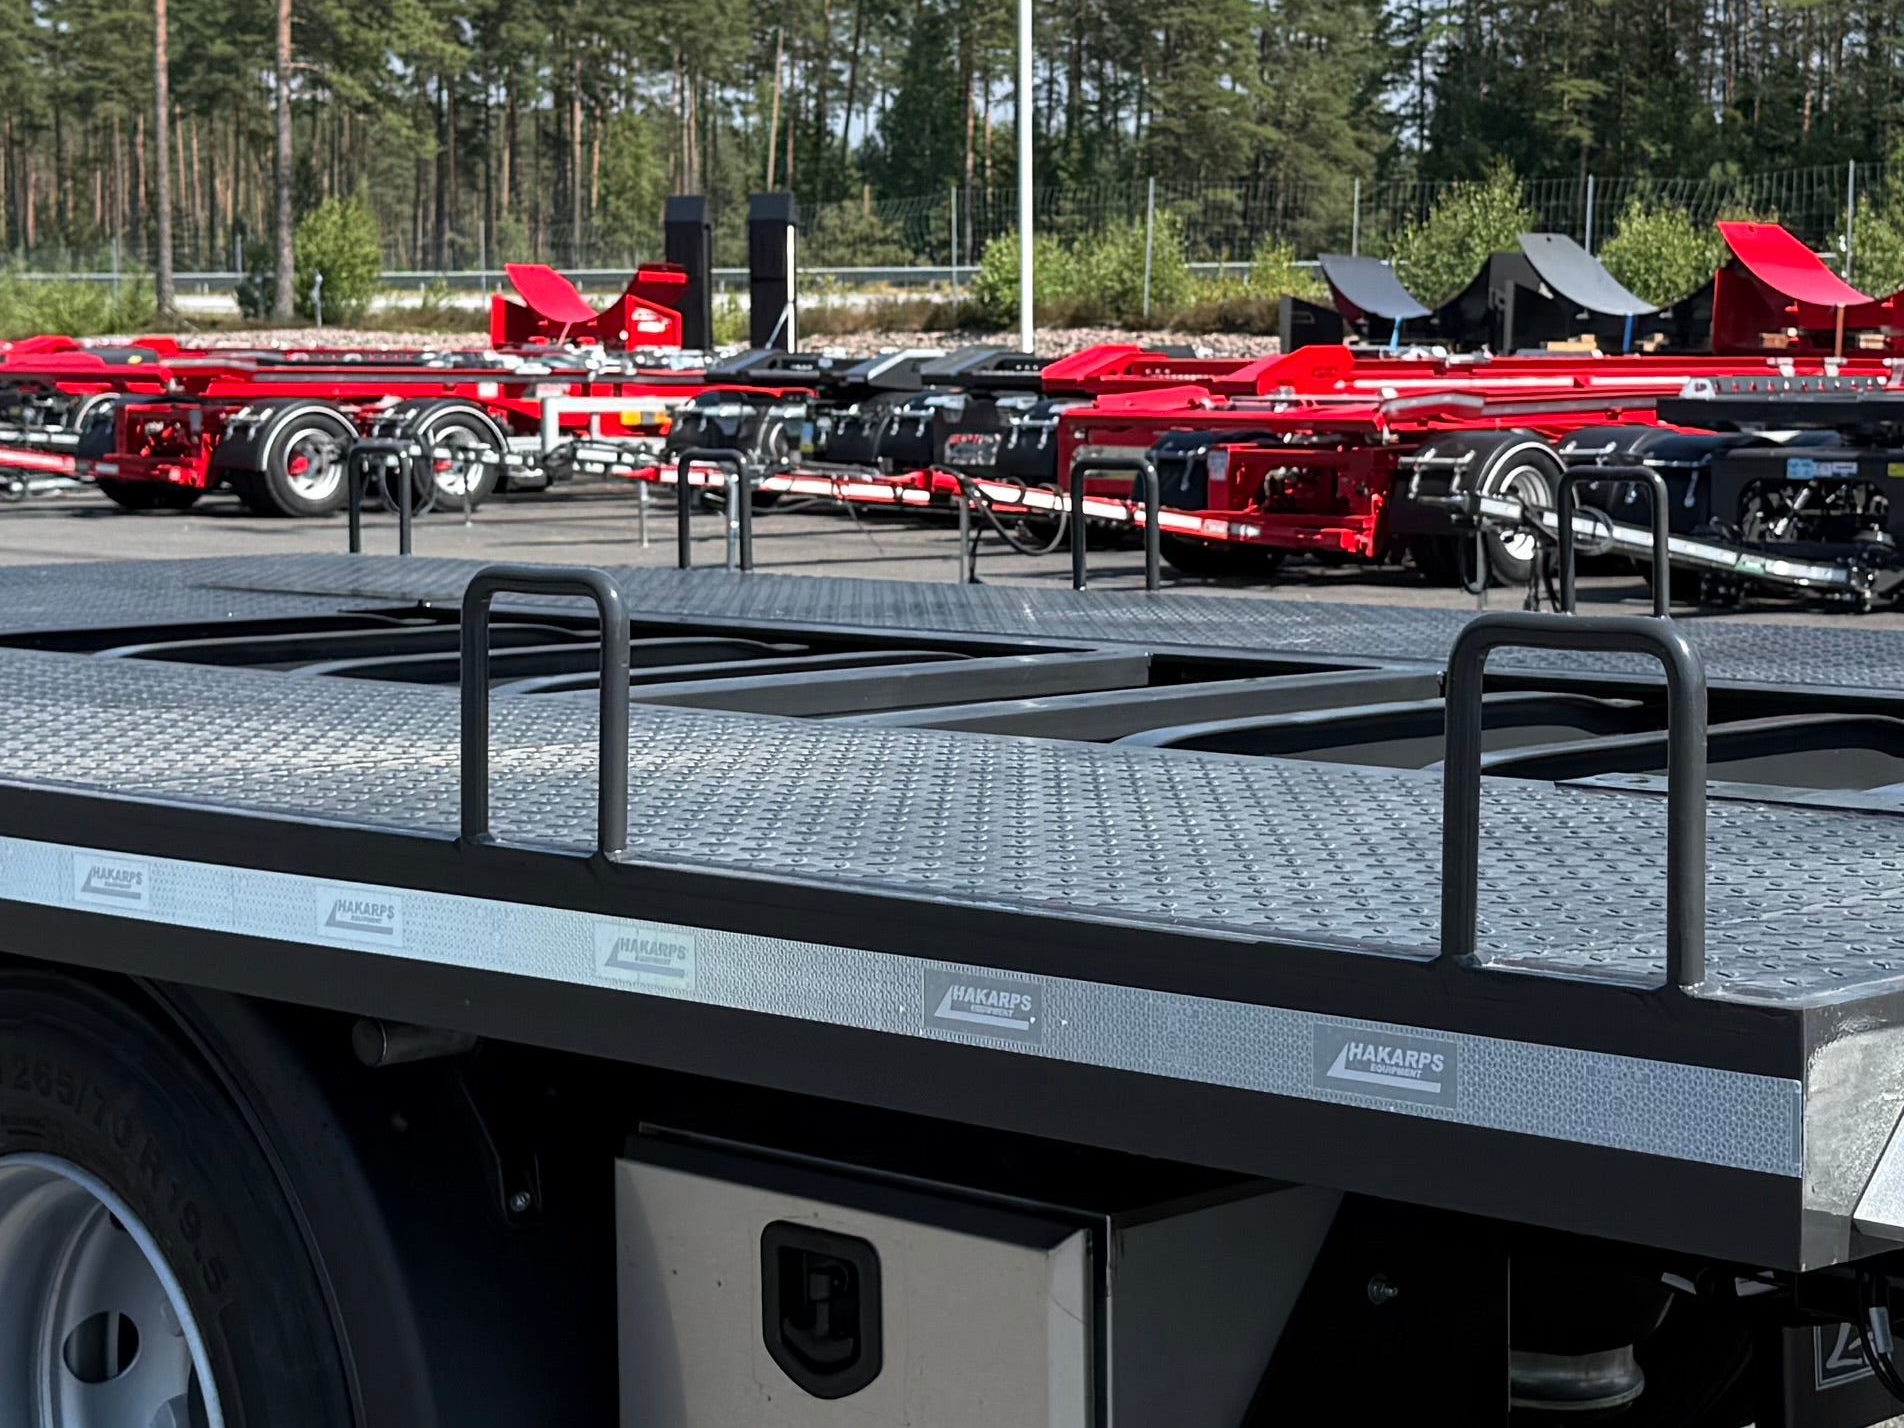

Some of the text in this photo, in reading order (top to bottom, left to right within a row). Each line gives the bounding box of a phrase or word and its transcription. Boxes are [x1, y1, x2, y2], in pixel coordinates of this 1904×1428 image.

[337, 899, 395, 920] HAKARPS
[619, 937, 687, 961] HAKARPS
[952, 984, 1032, 1012] HAKARPS
[1347, 1041, 1445, 1073] HAKARPS
[1369, 1062, 1423, 1079] EQUIPMENT
